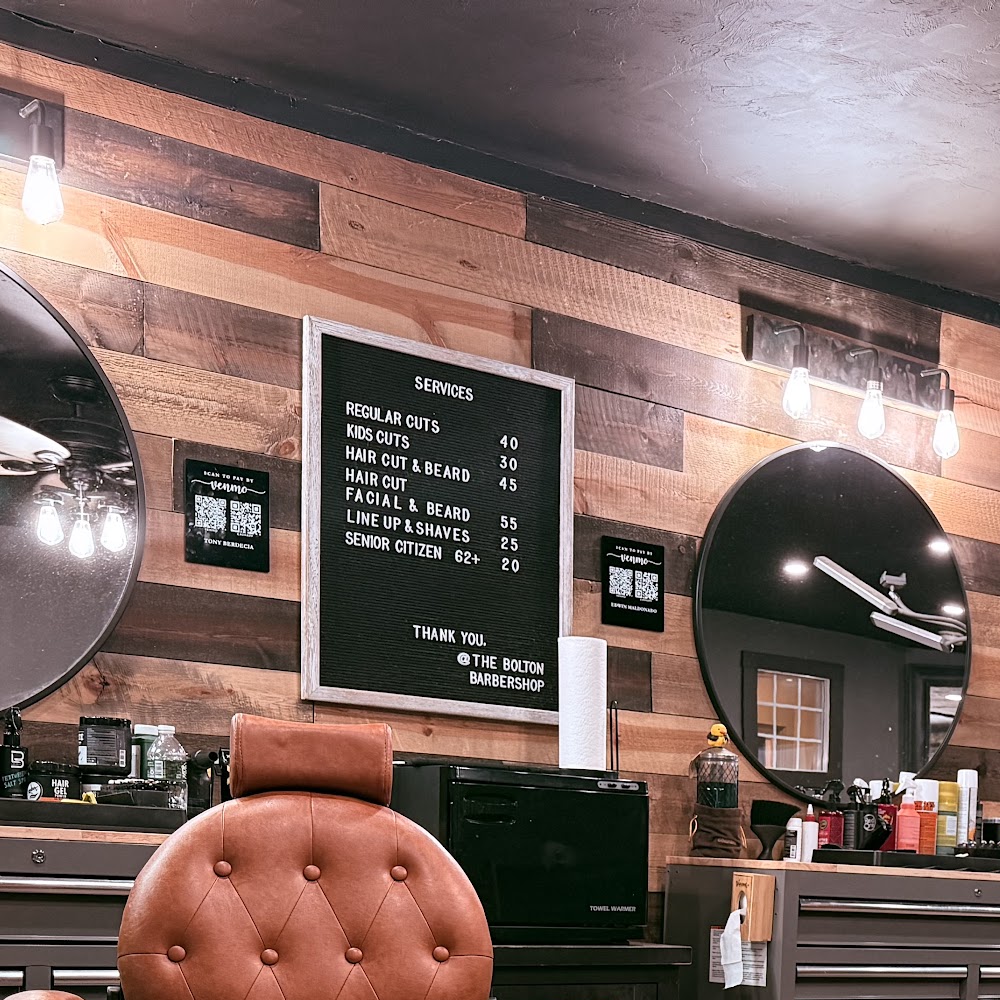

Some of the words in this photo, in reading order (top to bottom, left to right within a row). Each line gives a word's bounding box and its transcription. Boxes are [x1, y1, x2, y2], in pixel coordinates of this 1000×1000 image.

[414, 375, 474, 402] SERVICES
[345, 401, 402, 427] REGULAR
[406, 414, 440, 434] CUTS
[499, 434, 519, 451] 40
[346, 423, 374, 442] KIDS
[376, 429, 410, 450] CUTS
[499, 455, 518, 472] 30
[203, 470, 220, 478] SCAN
[345, 445, 377, 465] HAIR
[381, 452, 409, 471] CUT
[411, 458, 422, 473] &
[424, 461, 471, 483] BEARD
[498, 476, 518, 492] 45
[345, 467, 378, 487] HAIR
[381, 474, 408, 492] CUT
[345, 486, 403, 511] FACIAL
[408, 497, 419, 513] &
[426, 501, 471, 523] BEARD
[500, 515, 518, 531] 55
[203, 538, 222, 546] TONY
[346, 508, 380, 528] LINE
[383, 515, 402, 531] UP
[404, 519, 414, 534] &
[415, 521, 471, 543] SHAVES
[500, 536, 519, 552] 25
[345, 531, 391, 552] SENIOR
[394, 539, 442, 561] CITIZEN
[454, 549, 481, 565] 62+
[501, 557, 520, 573] 20
[412, 624, 456, 644] THANK
[460, 630, 487, 647] YOU.
[471, 653, 498, 670] THE
[502, 657, 545, 676] BOLTON
[469, 670, 545, 693] BARBERSHOP
[51, 779, 70, 788] HAIR
[53, 787, 68, 795] GEL
